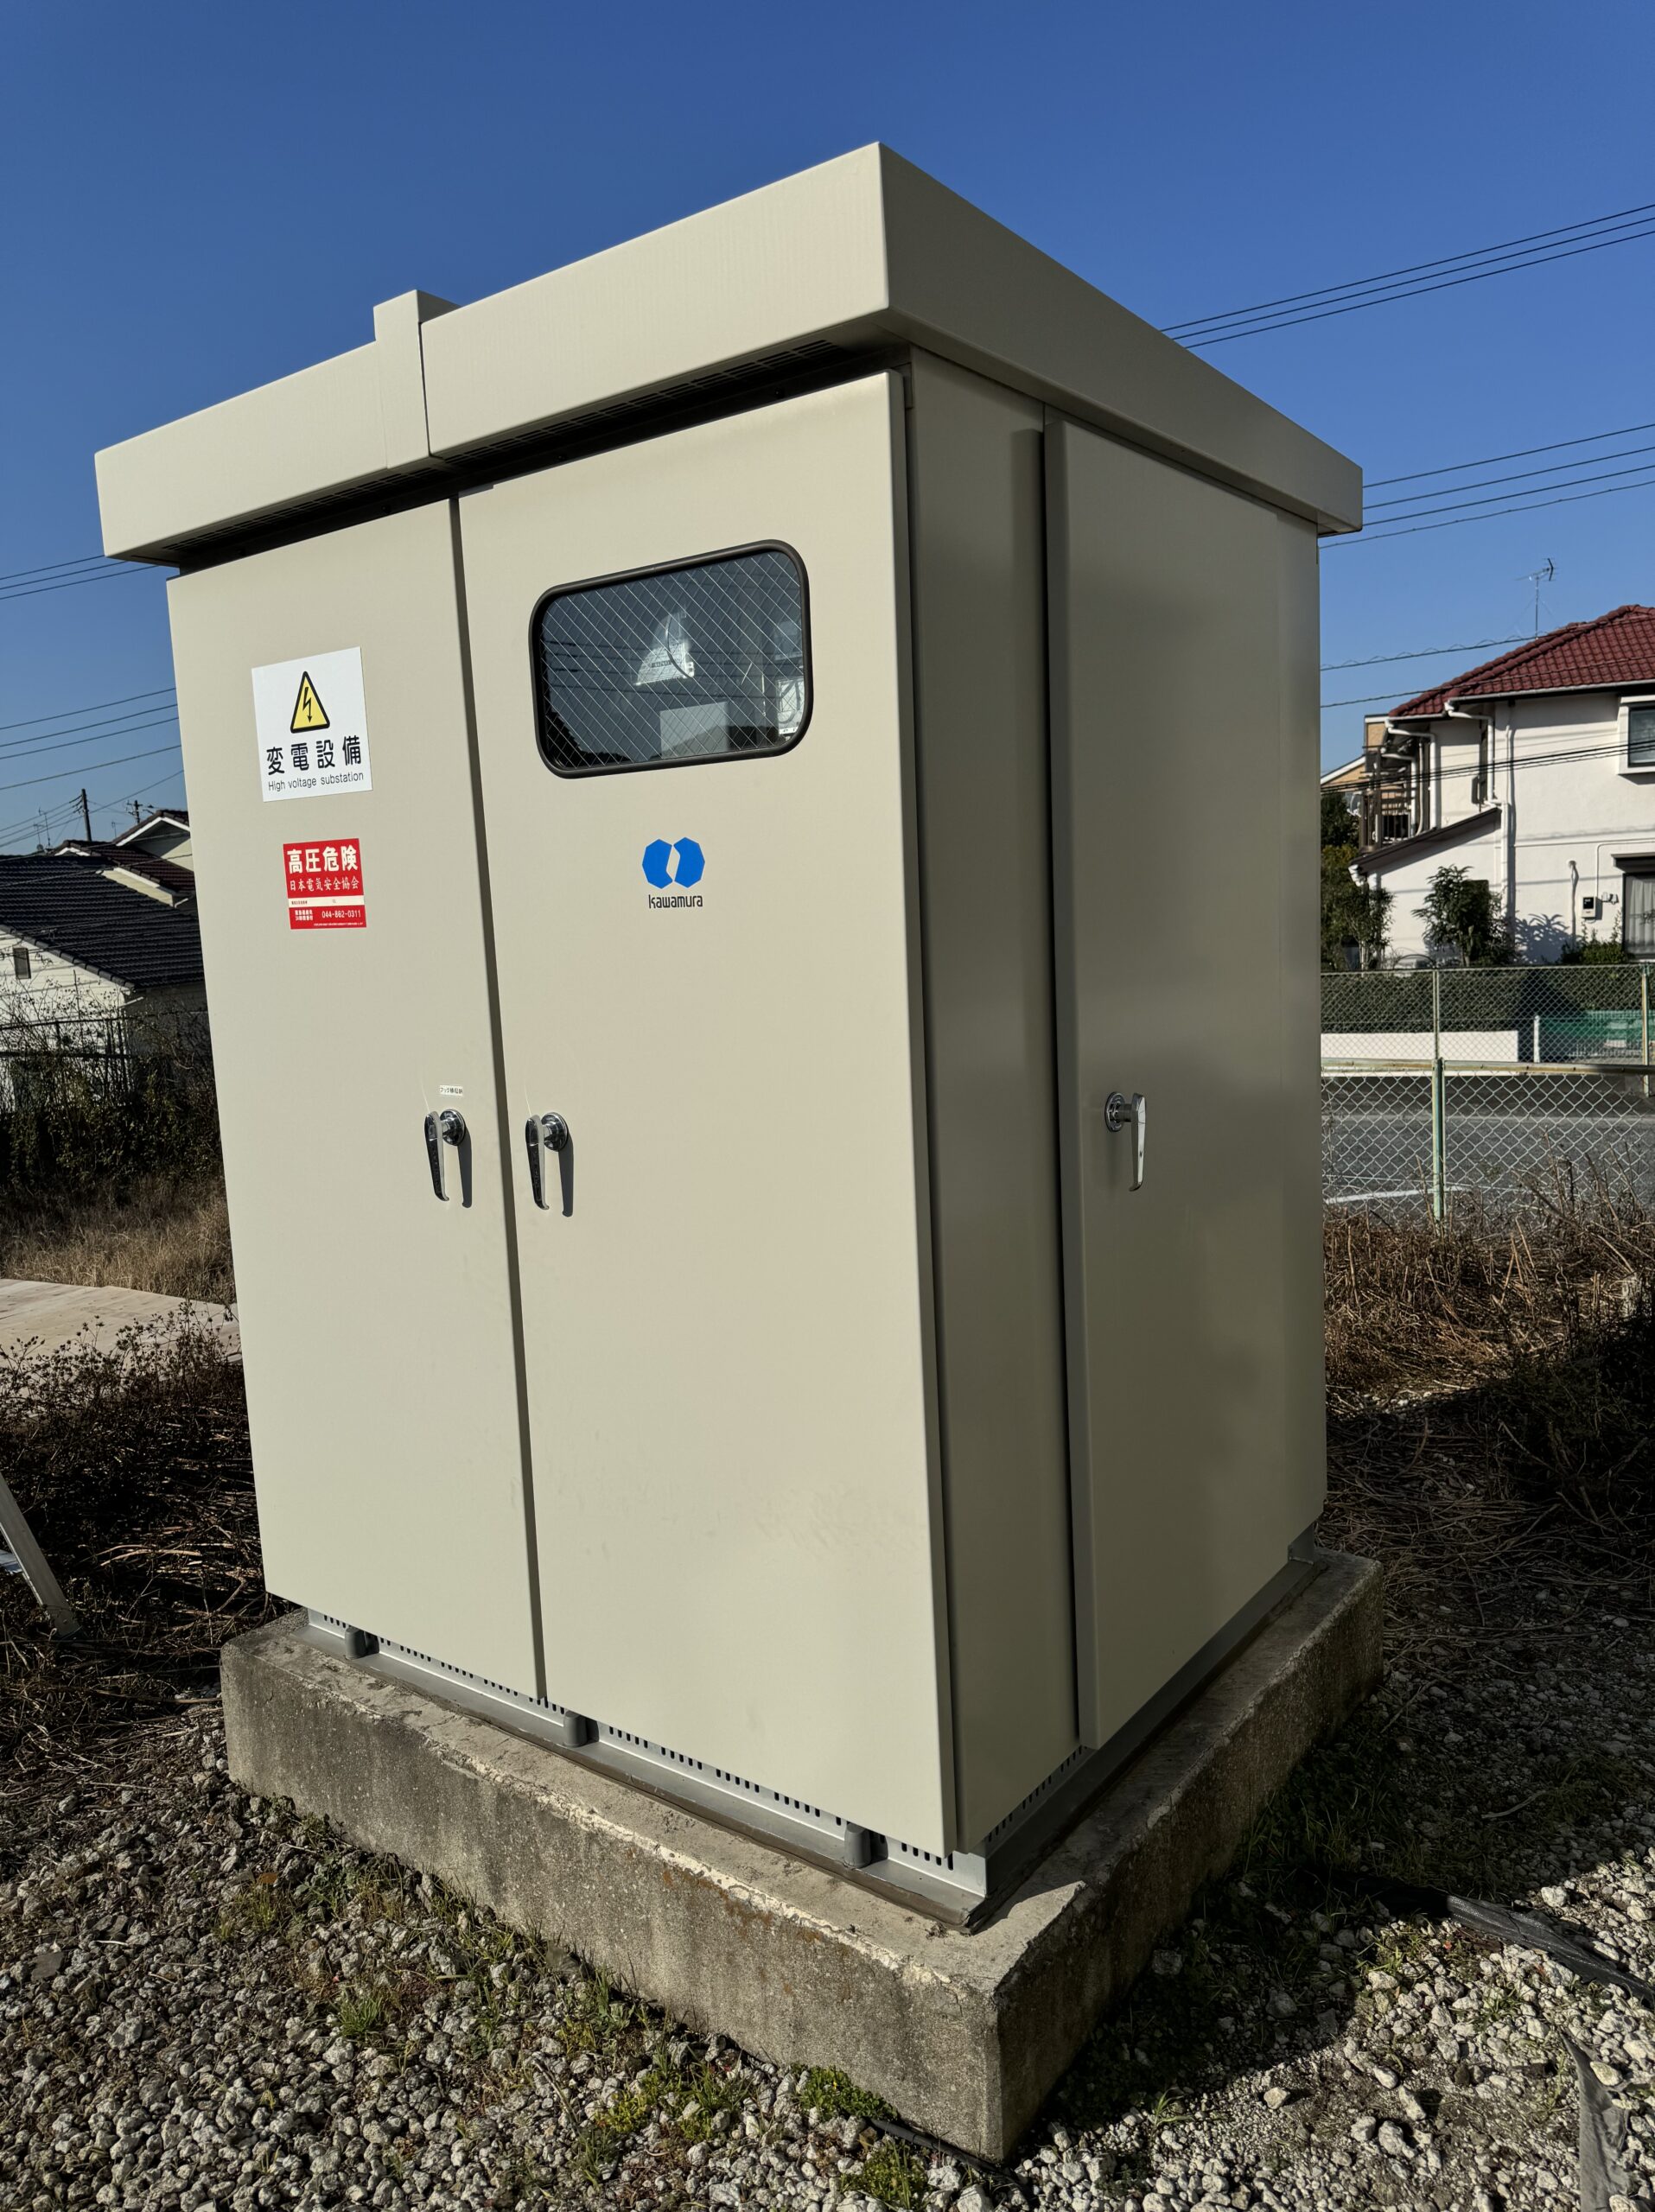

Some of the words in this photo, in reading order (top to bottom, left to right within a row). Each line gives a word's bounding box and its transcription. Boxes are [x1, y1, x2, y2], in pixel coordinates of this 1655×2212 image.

[266, 735, 362, 776] 変電設備
[268, 780, 286, 792] High
[288, 777, 317, 790] voltage
[321, 771, 364, 785] substation
[287, 845, 358, 874] 高圧危険
[290, 875, 359, 892] 日本電気安全協会
[648, 894, 703, 909] kawamura
